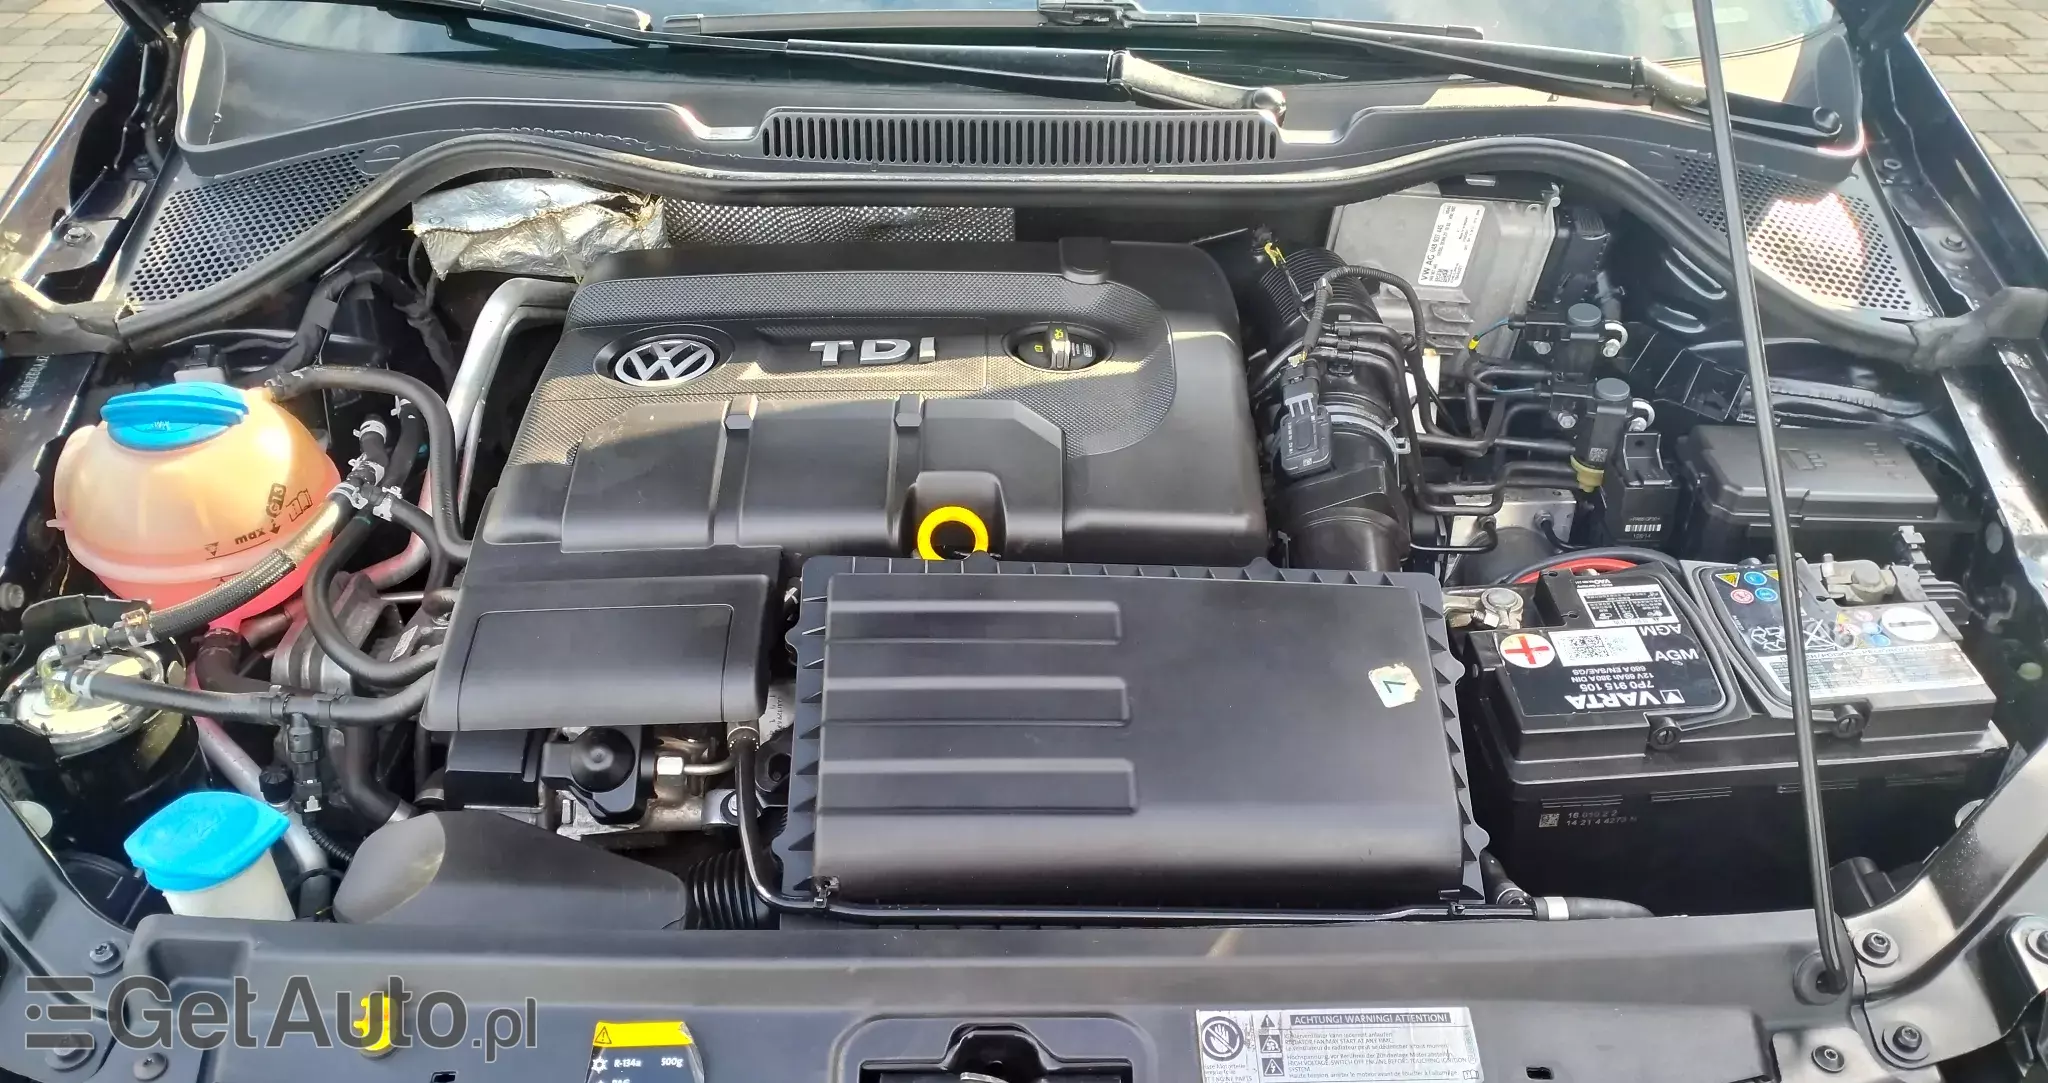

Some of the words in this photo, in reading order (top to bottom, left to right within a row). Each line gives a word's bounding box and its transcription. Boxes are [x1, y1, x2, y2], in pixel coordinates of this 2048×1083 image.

[809, 336, 937, 366] TDI
[235, 527, 266, 545] max
[1639, 623, 1682, 637] AGM
[1655, 649, 1699, 662] AGM
[1637, 672, 1655, 680] 12V
[1580, 682, 1603, 692] 105
[1604, 681, 1627, 690] 915
[1629, 680, 1655, 689] 7P0
[1564, 690, 1662, 710] VARTA
[1294, 1015, 1343, 1024] ACHTUNG!
[1344, 1014, 1392, 1023] WARNING!
[1395, 1013, 1448, 1022] ATTENTION!
[614, 1059, 642, 1068] R-134a
[661, 1057, 684, 1068] 500g
